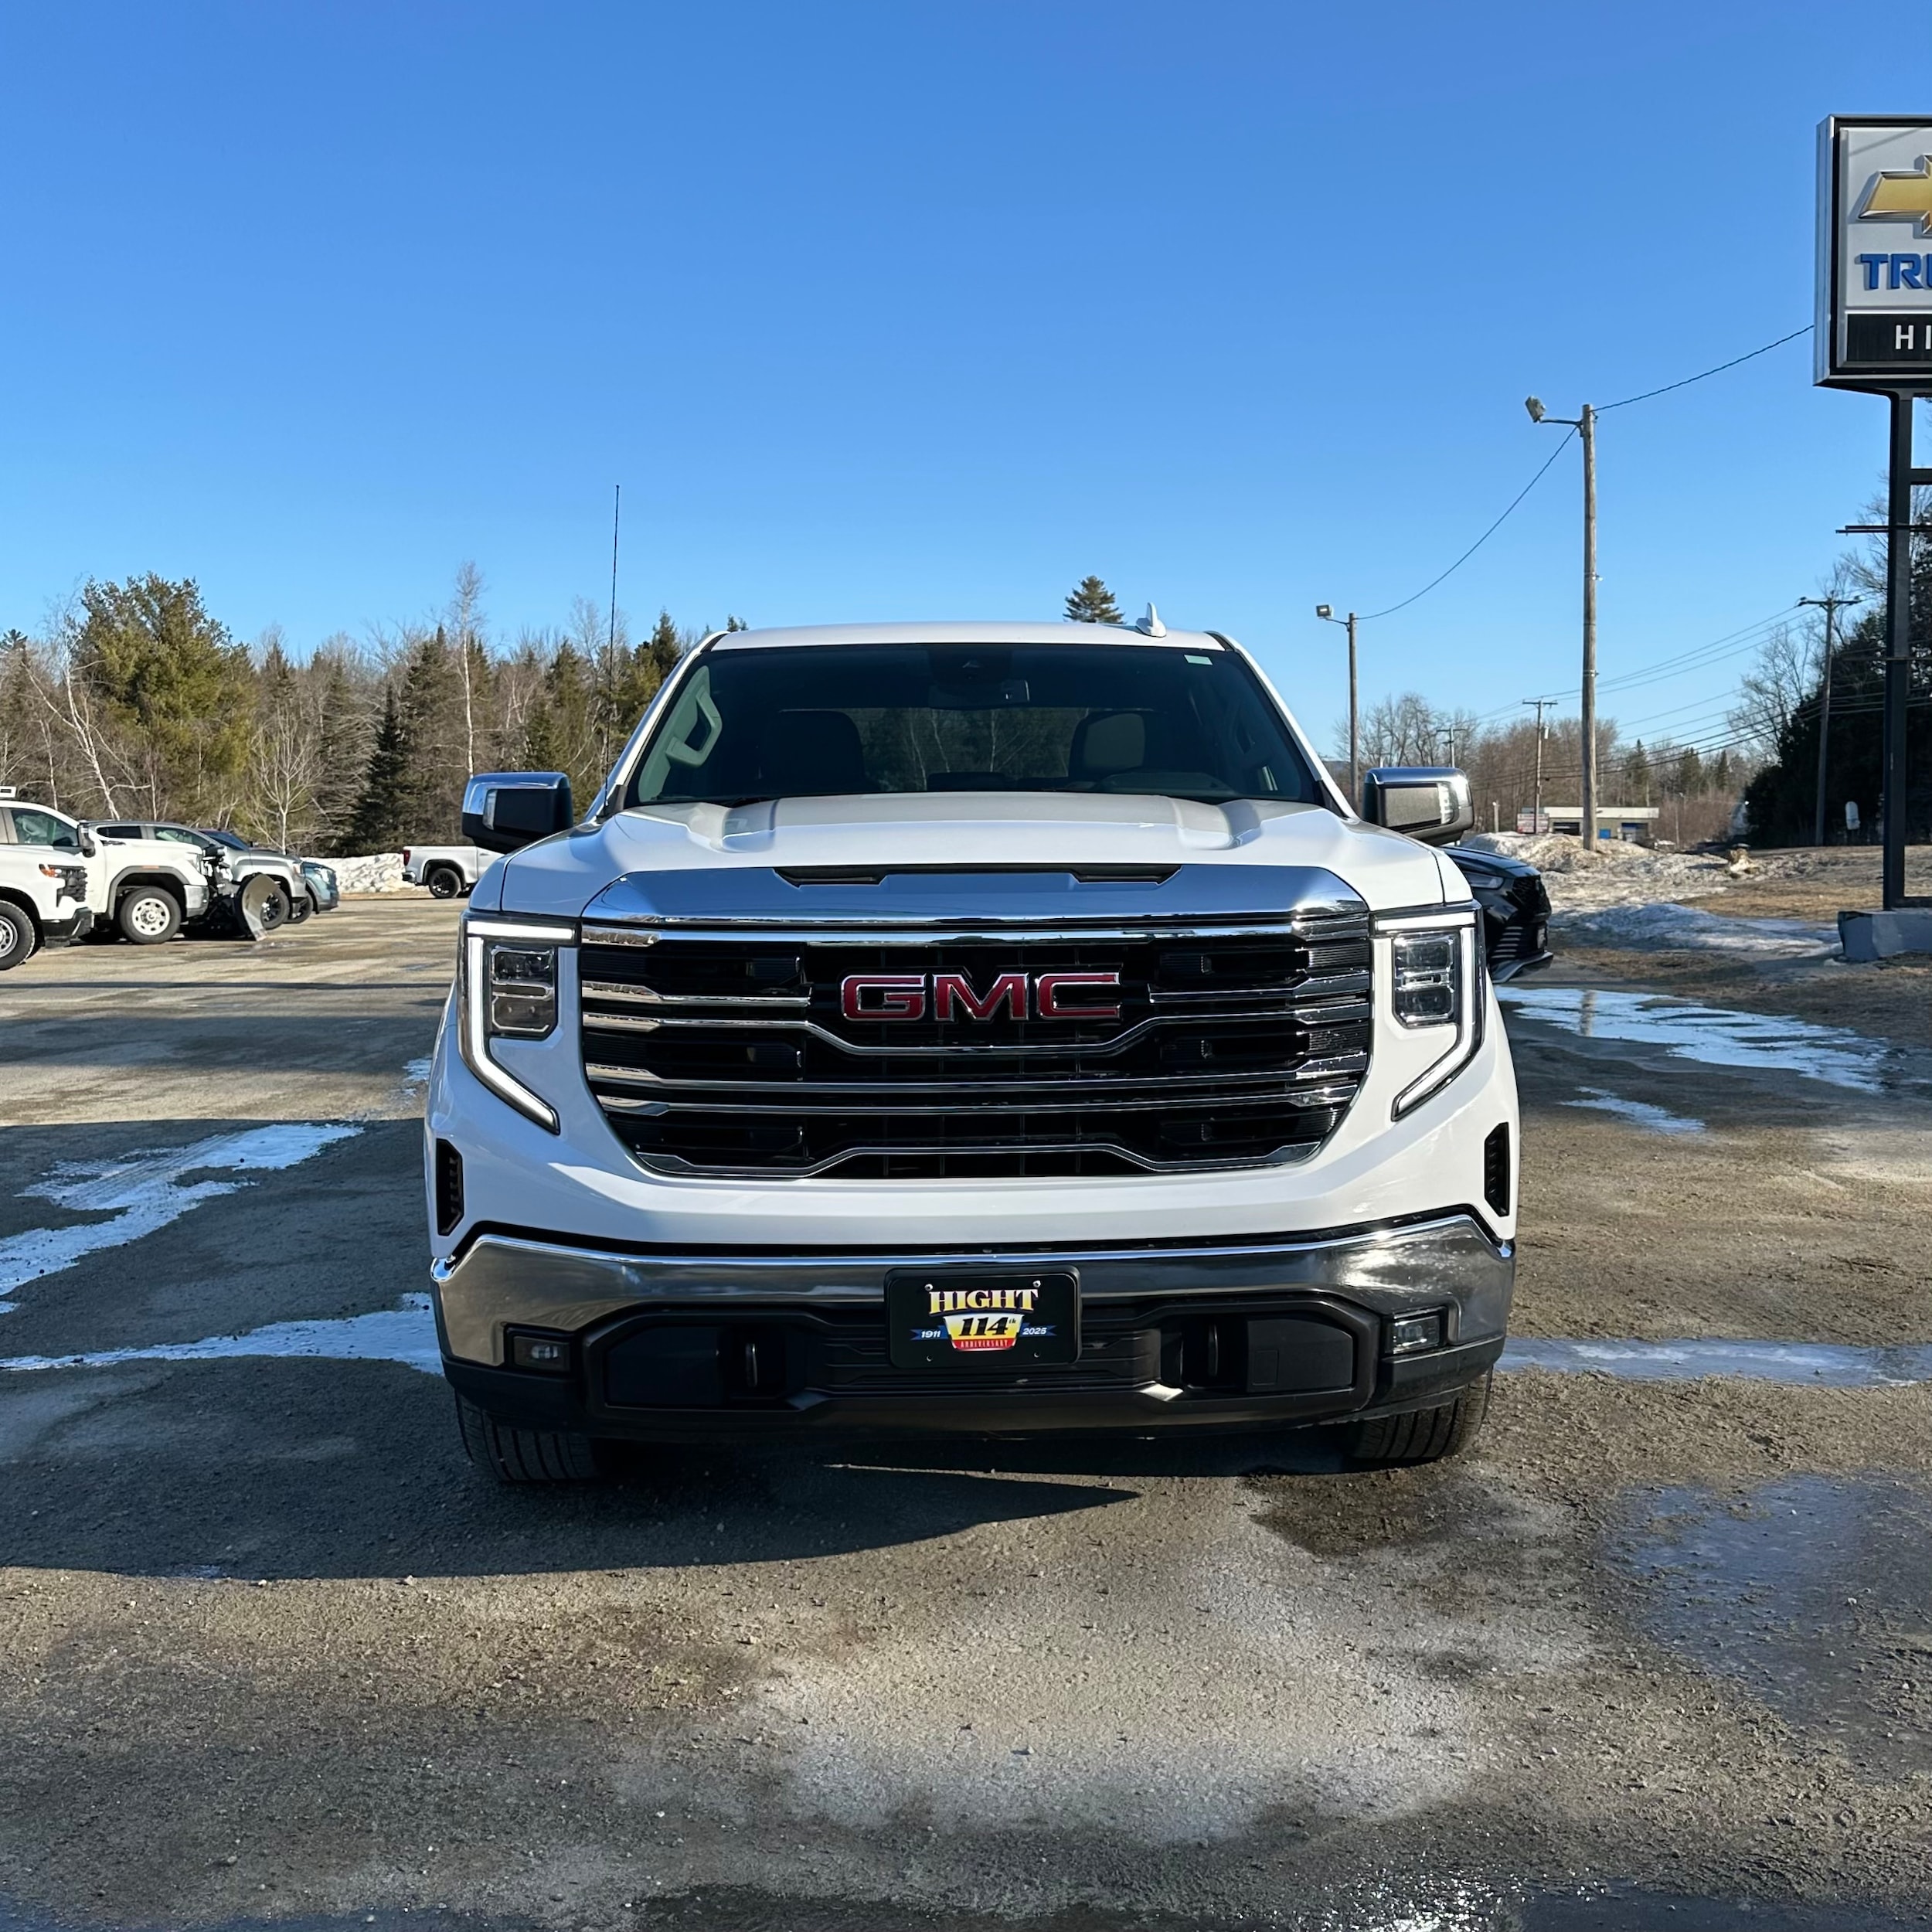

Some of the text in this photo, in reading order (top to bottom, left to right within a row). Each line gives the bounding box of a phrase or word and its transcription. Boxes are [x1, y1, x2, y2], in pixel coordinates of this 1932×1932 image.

[1860, 253, 1932, 289] TR
[841, 972, 1121, 1022] GMC
[929, 1288, 1039, 1315] HIGHT
[920, 1330, 941, 1338] 1911
[1022, 1327, 1048, 1335] 2025
